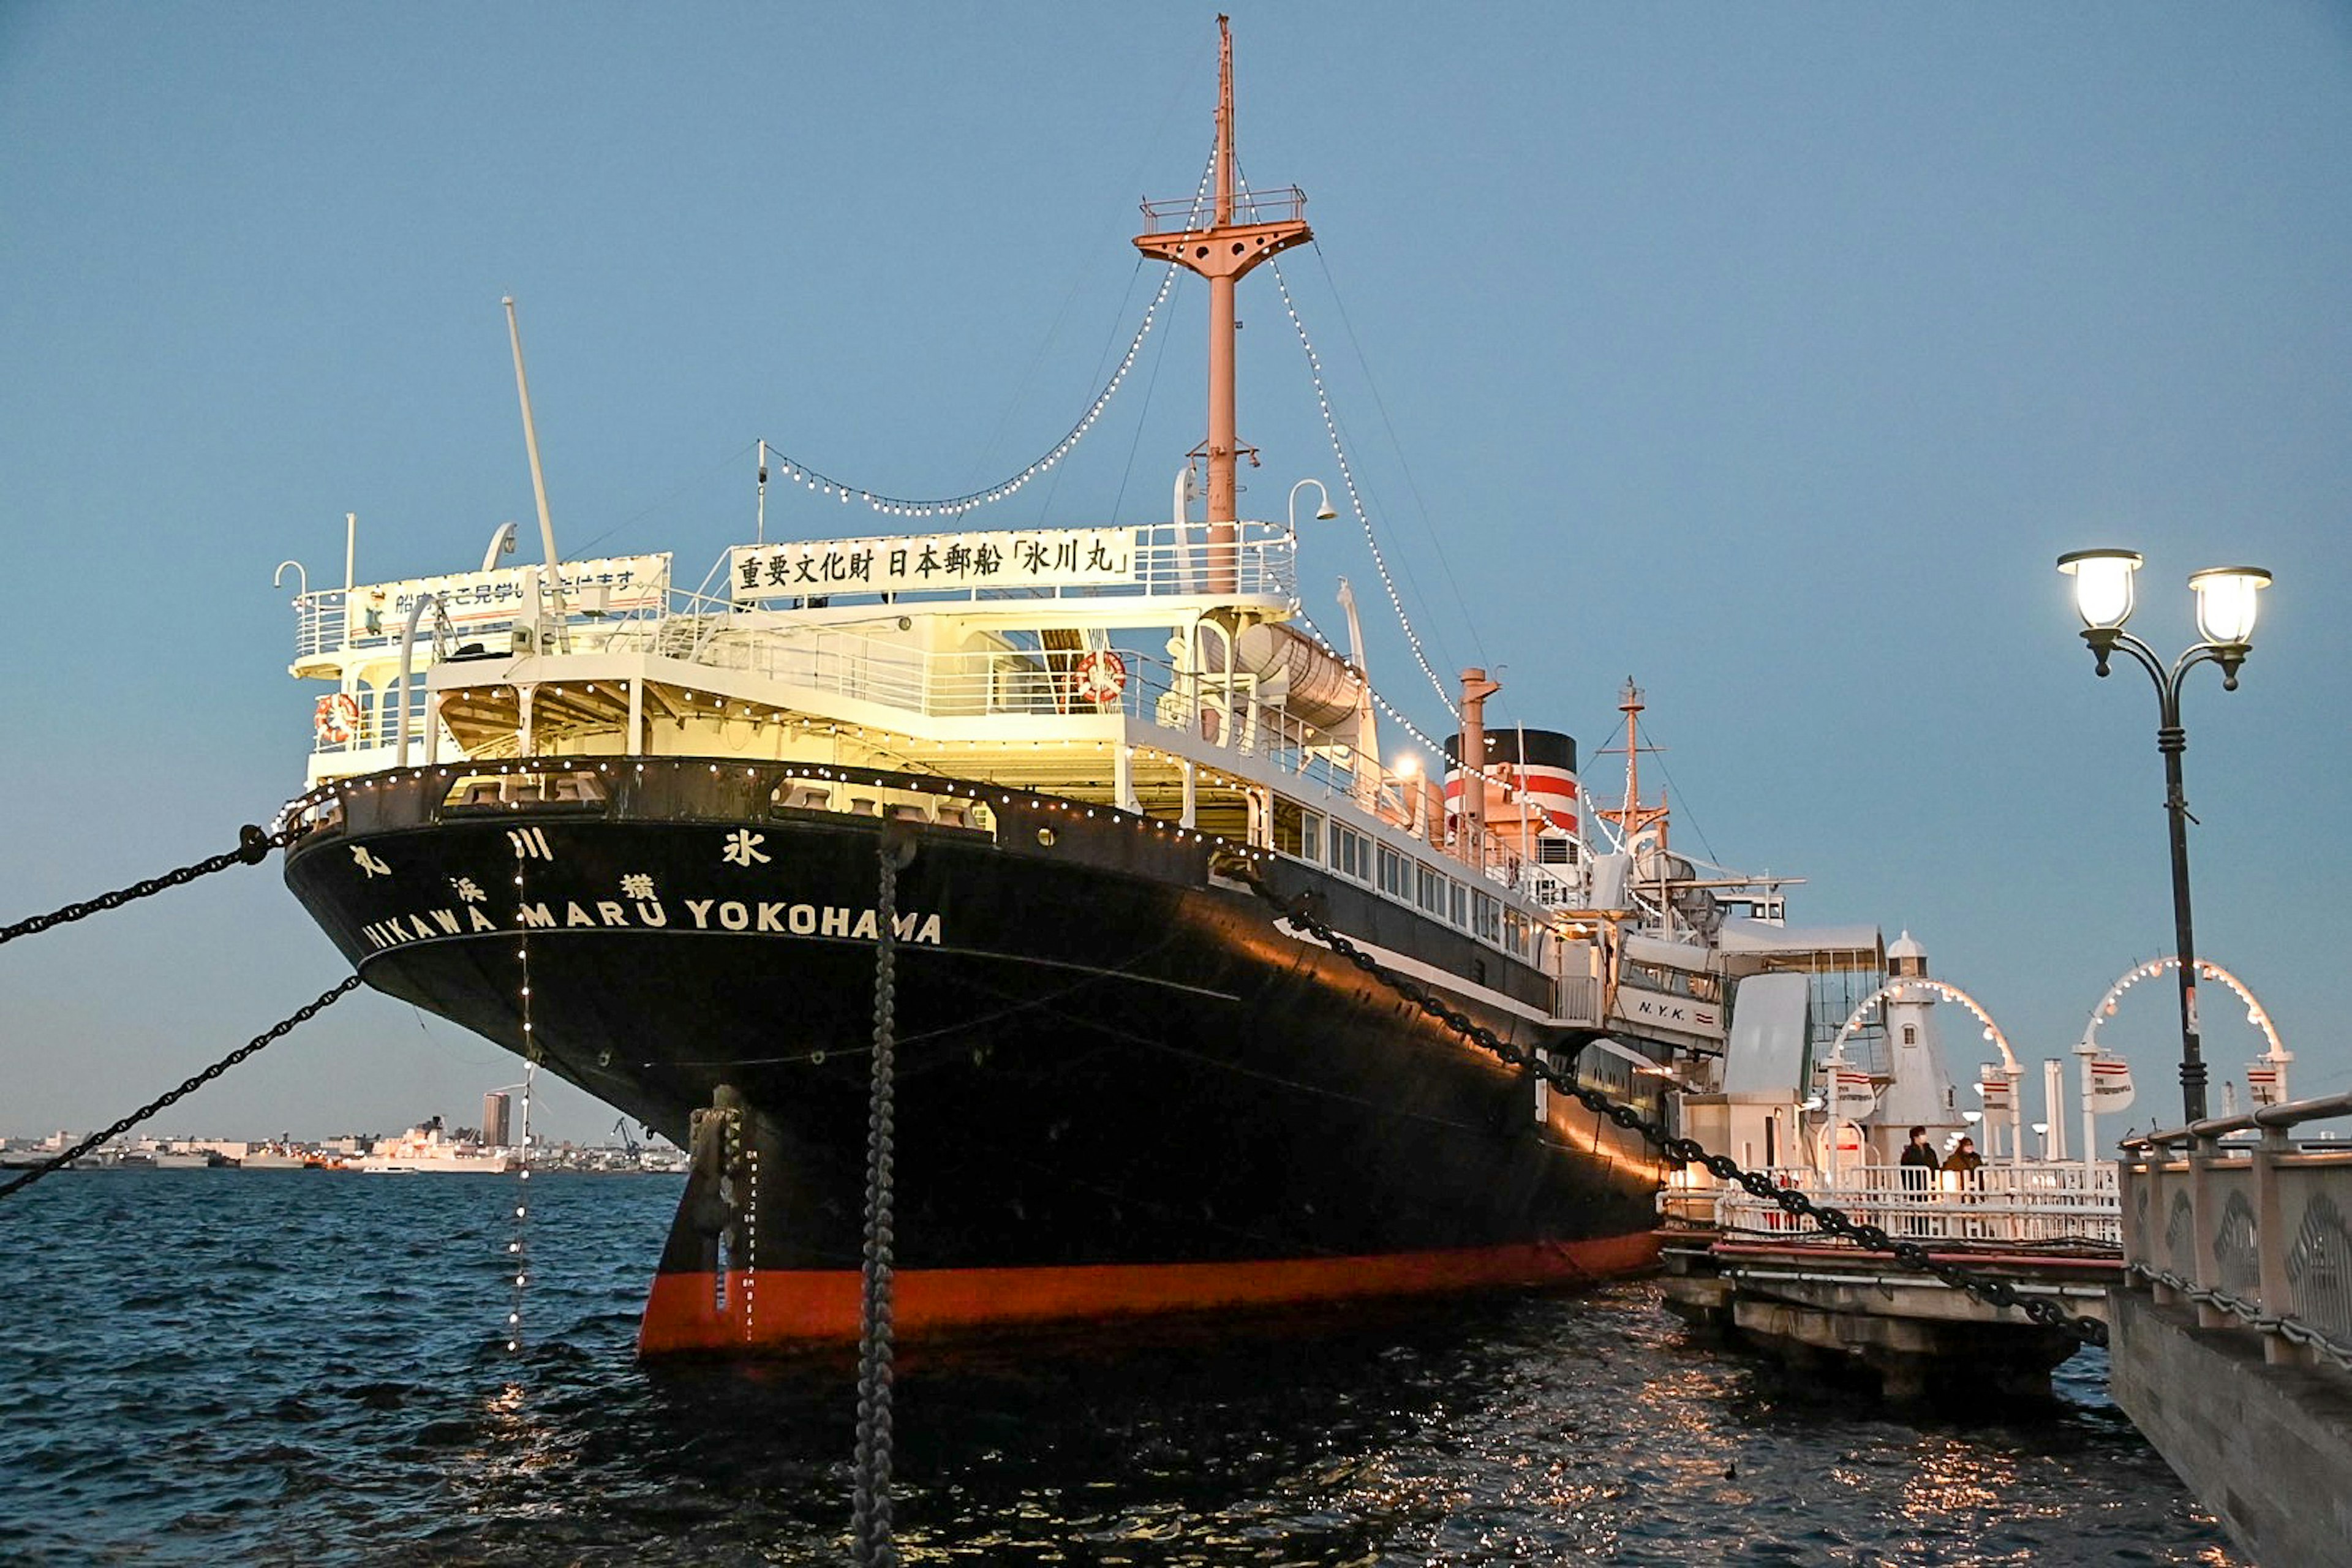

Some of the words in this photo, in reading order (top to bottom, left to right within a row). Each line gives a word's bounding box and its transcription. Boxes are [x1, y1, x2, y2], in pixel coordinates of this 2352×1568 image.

[738, 548, 875, 590] 重要文化財
[361, 905, 497, 949] HIKAWA
[519, 900, 668, 927] MARU
[684, 899, 941, 945] YOKOHAMA
